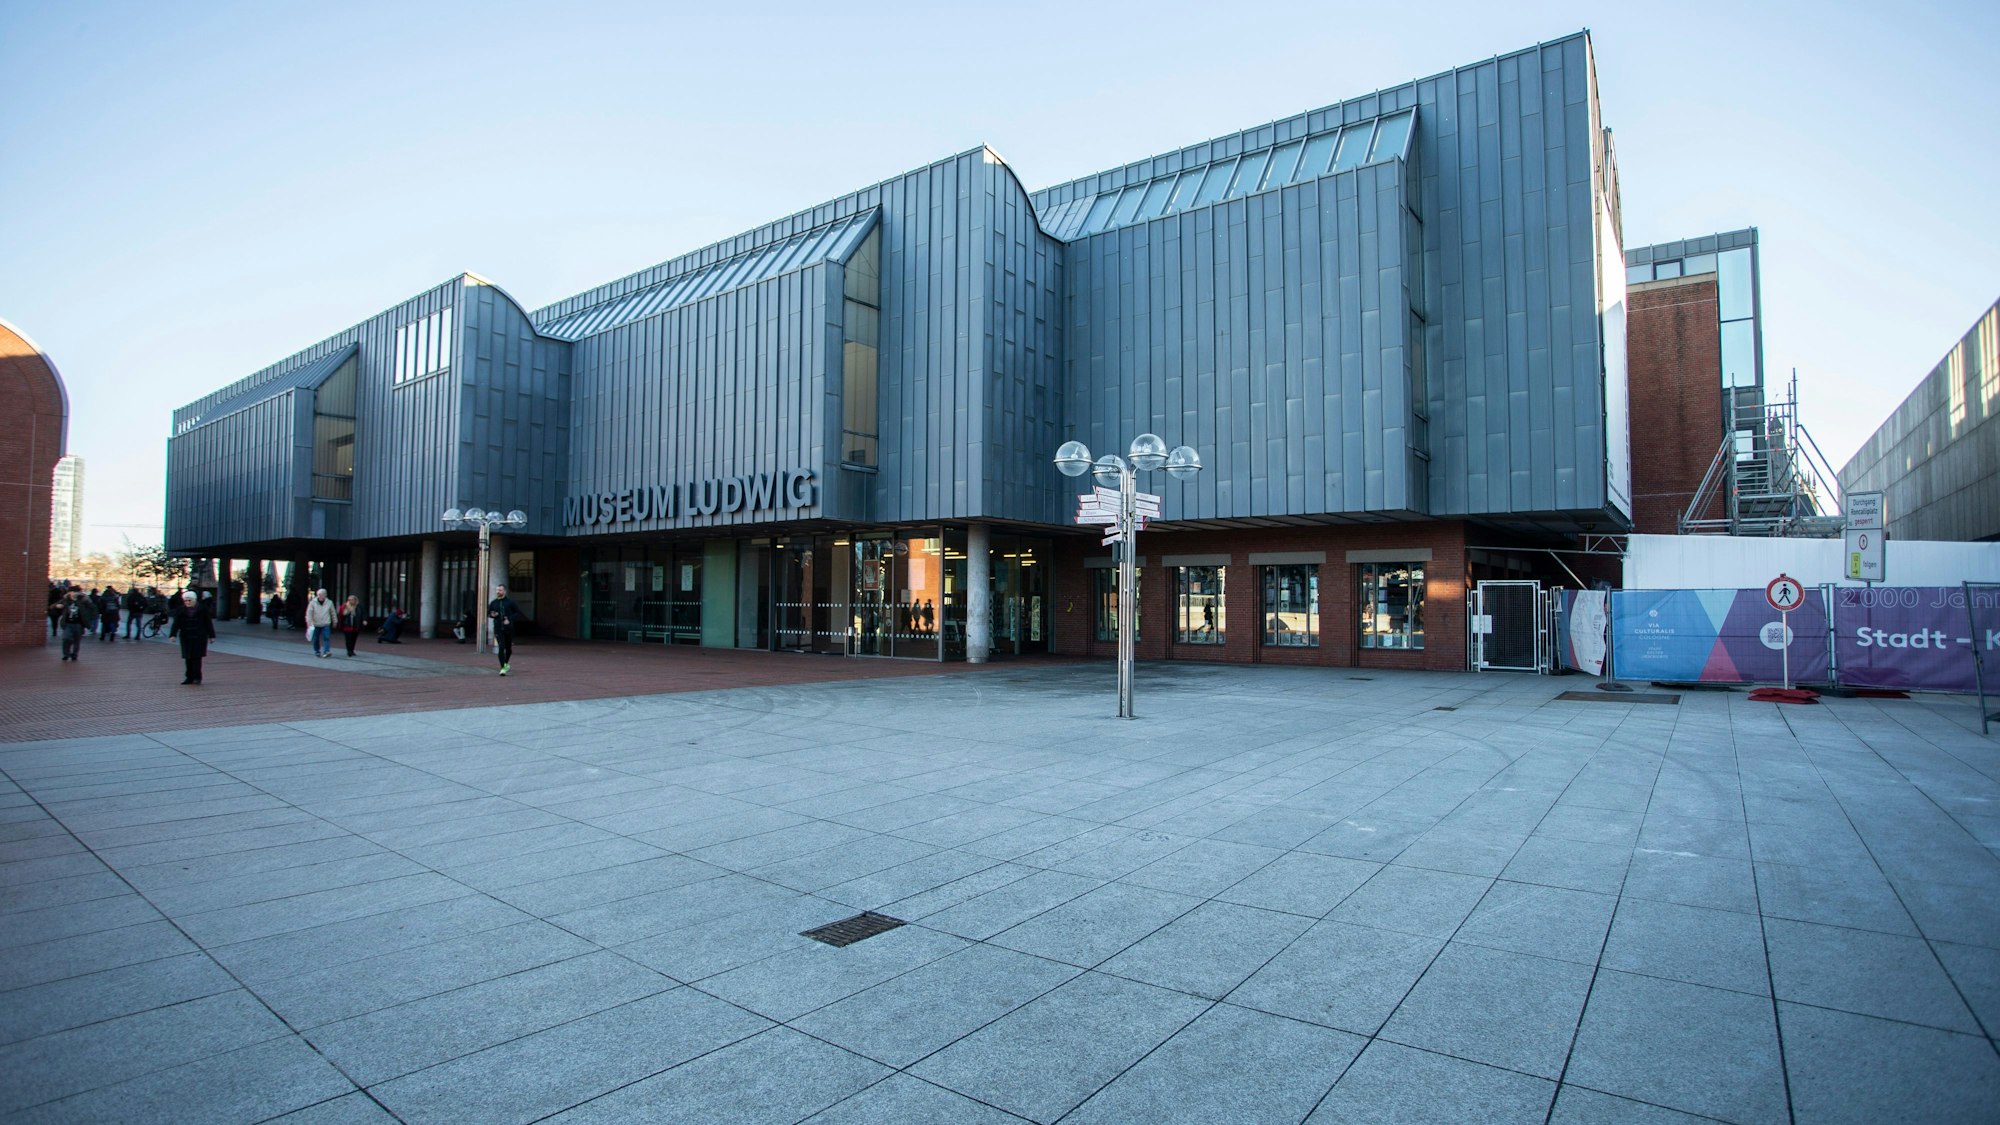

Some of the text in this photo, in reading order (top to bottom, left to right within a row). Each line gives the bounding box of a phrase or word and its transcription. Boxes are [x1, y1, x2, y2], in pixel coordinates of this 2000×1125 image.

[562, 467, 814, 528] MUSEUM LUDWIG
[1840, 587, 1919, 609] 2000
[1856, 626, 1947, 649] Stadt
